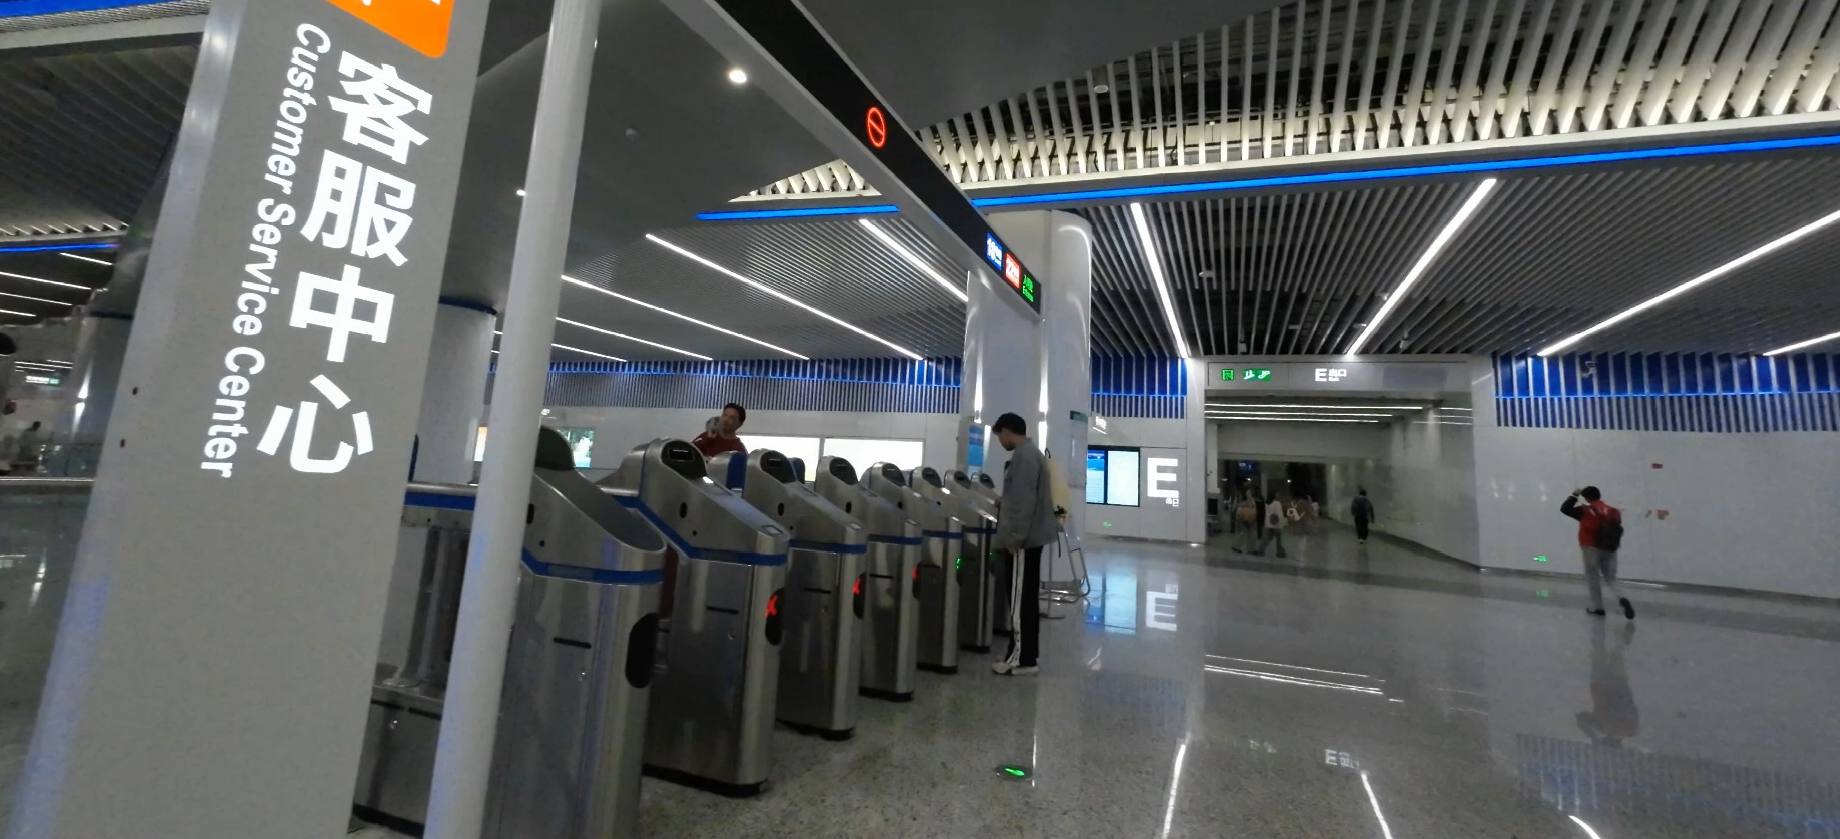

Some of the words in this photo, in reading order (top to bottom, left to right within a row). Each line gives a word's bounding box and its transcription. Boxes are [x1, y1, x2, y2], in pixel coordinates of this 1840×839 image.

[266, 23, 331, 196] Customer
[233, 198, 296, 336] Service
[256, 50, 433, 474] 客服中心
[200, 346, 266, 478] Center
[1147, 458, 1179, 498] E
